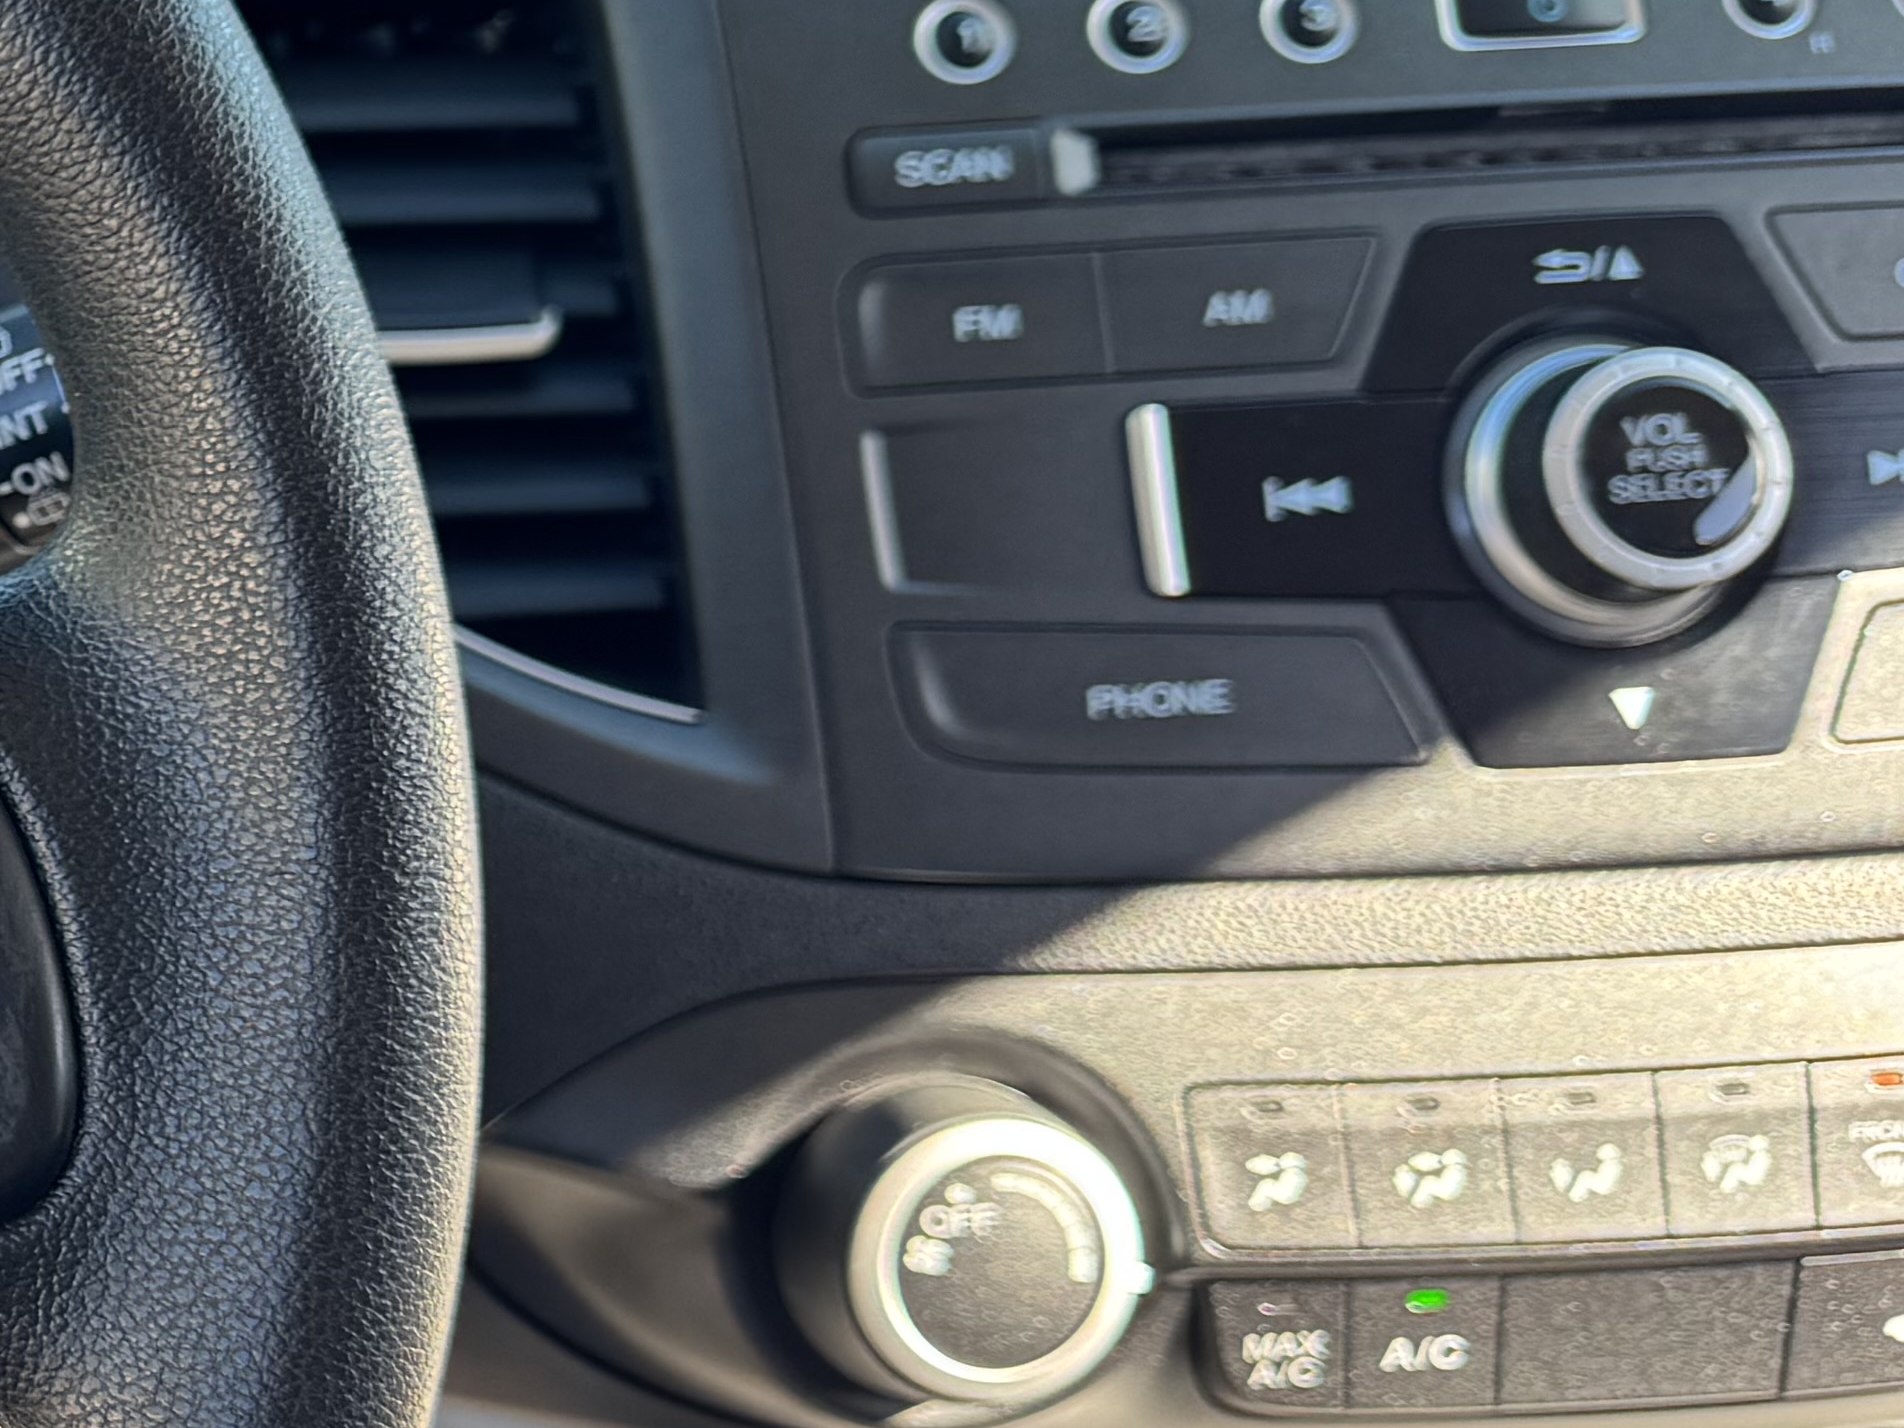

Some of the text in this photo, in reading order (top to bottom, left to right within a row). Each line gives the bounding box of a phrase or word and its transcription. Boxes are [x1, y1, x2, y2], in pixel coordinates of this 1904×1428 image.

[958, 15, 987, 53] 1
[1127, 5, 1167, 42] 2
[895, 146, 1014, 188] SCAN
[953, 303, 1023, 343] FM
[1202, 288, 1274, 328] AM
[1620, 413, 1703, 445] VOL
[10, 451, 70, 495] ON
[1625, 445, 1709, 472] PUSH
[1607, 468, 1731, 504] SELECT
[1086, 678, 1236, 721] PHONE
[919, 1202, 1002, 1240] OFF
[1242, 1329, 1330, 1364] MAX
[1379, 1333, 1473, 1372] A/C
[1247, 1356, 1329, 1390] A/C
